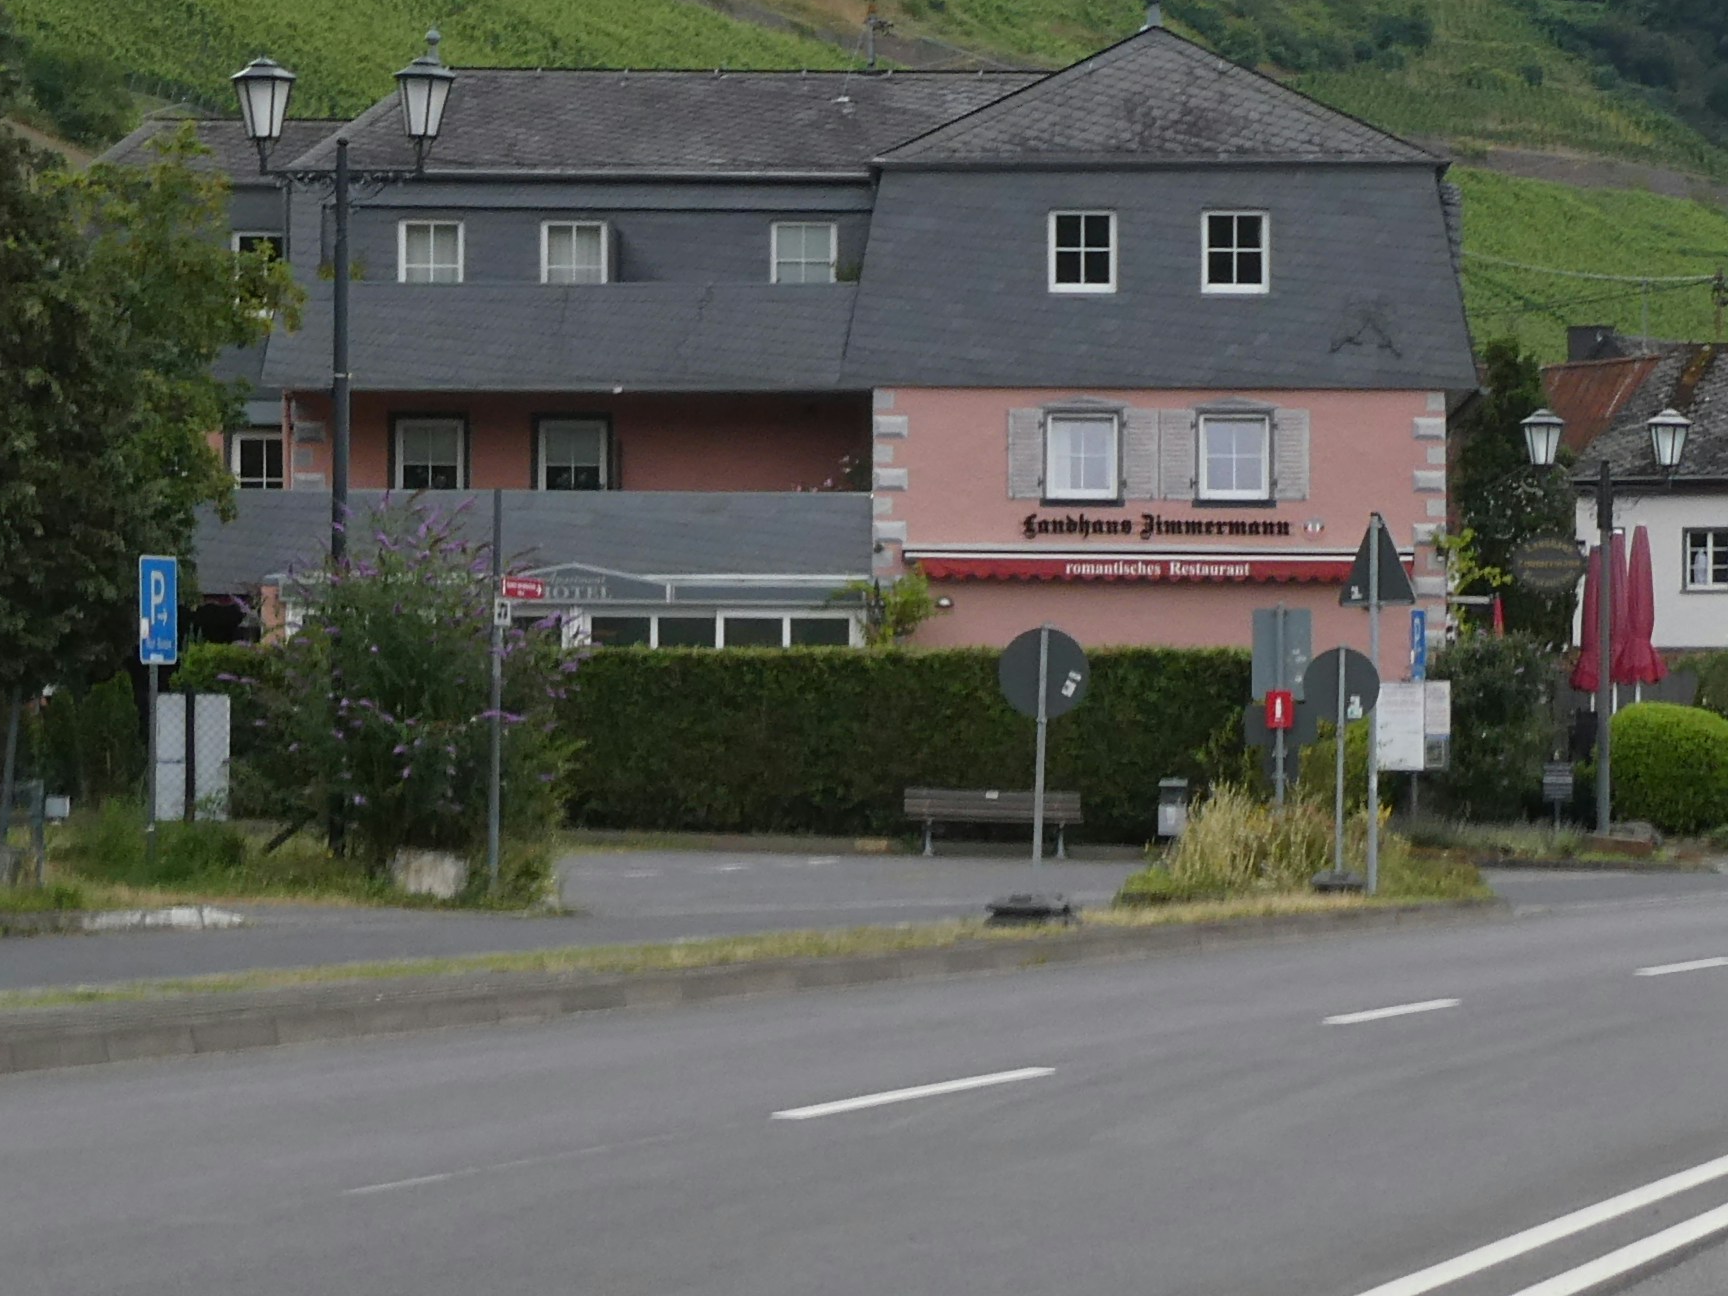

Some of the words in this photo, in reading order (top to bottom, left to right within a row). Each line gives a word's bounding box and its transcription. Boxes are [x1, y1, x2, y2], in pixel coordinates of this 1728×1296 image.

[1022, 512, 1133, 540] Landhaus
[1139, 512, 1291, 541] Zimmermann
[1065, 561, 1162, 576] romantisches
[1169, 561, 1250, 577] Restaurant
[150, 570, 165, 625] P
